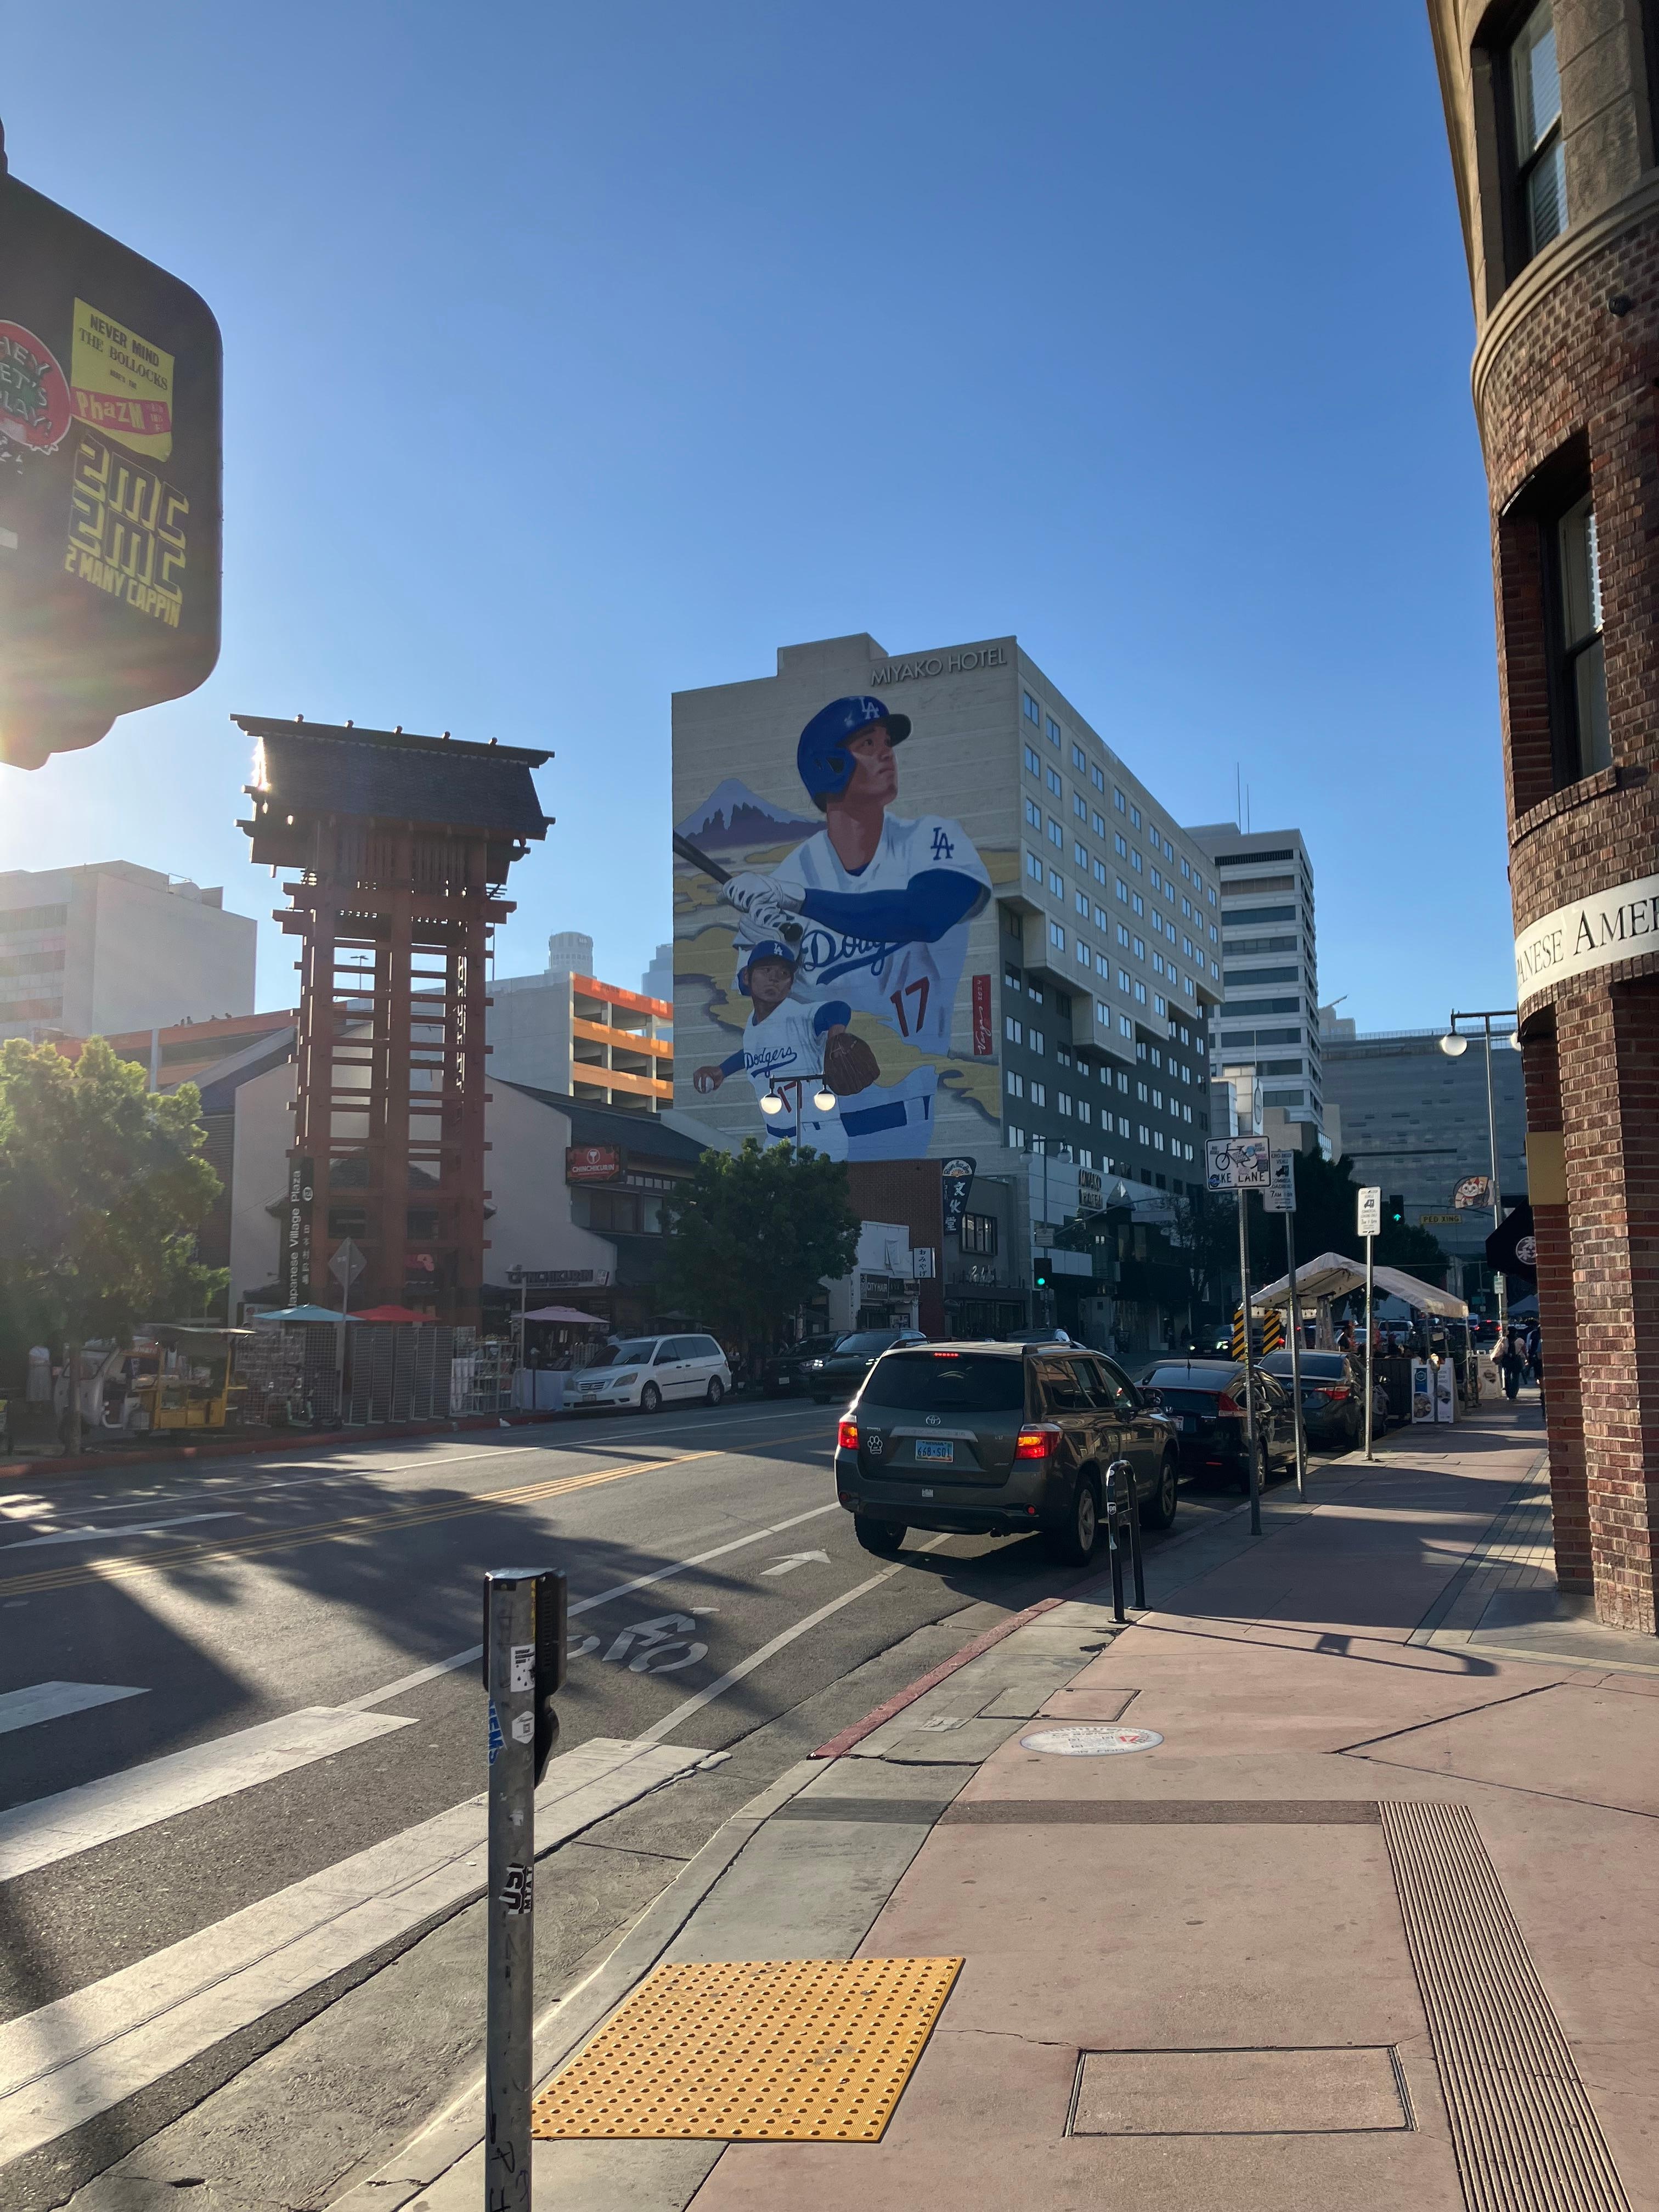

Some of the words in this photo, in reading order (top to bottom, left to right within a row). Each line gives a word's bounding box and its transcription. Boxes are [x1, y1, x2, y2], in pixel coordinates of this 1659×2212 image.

[90, 314, 127, 348] NEVER
[132, 340, 159, 367] MIND
[79, 328, 104, 353] THE
[110, 346, 168, 391] BOLLOCKS
[0, 390, 52, 436] LAY!
[64, 544, 77, 573] 2
[79, 552, 126, 597] MANY
[126, 577, 181, 629] CAPPIN
[871, 658, 944, 686] MIYAKO
[949, 647, 1008, 673] HOTEL
[859, 696, 880, 720] LA
[930, 826, 955, 861] LA
[773, 943, 783, 957] LA
[890, 976, 930, 1038] 17
[744, 1046, 793, 1079] Dodgers
[291, 1170, 301, 1202] Plaza
[572, 1164, 615, 1173] CHINCHIKURIN
[1217, 1173, 1232, 1183] KE
[1238, 1171, 1265, 1182] LANE
[945, 1181, 966, 1232] 文化堂
[290, 1207, 301, 1248] Village
[288, 1251, 299, 1308] Japanese
[918, 1249, 927, 1277] おみやげ
[867, 1282, 877, 1291] CITY
[877, 1282, 888, 1293] HAIR
